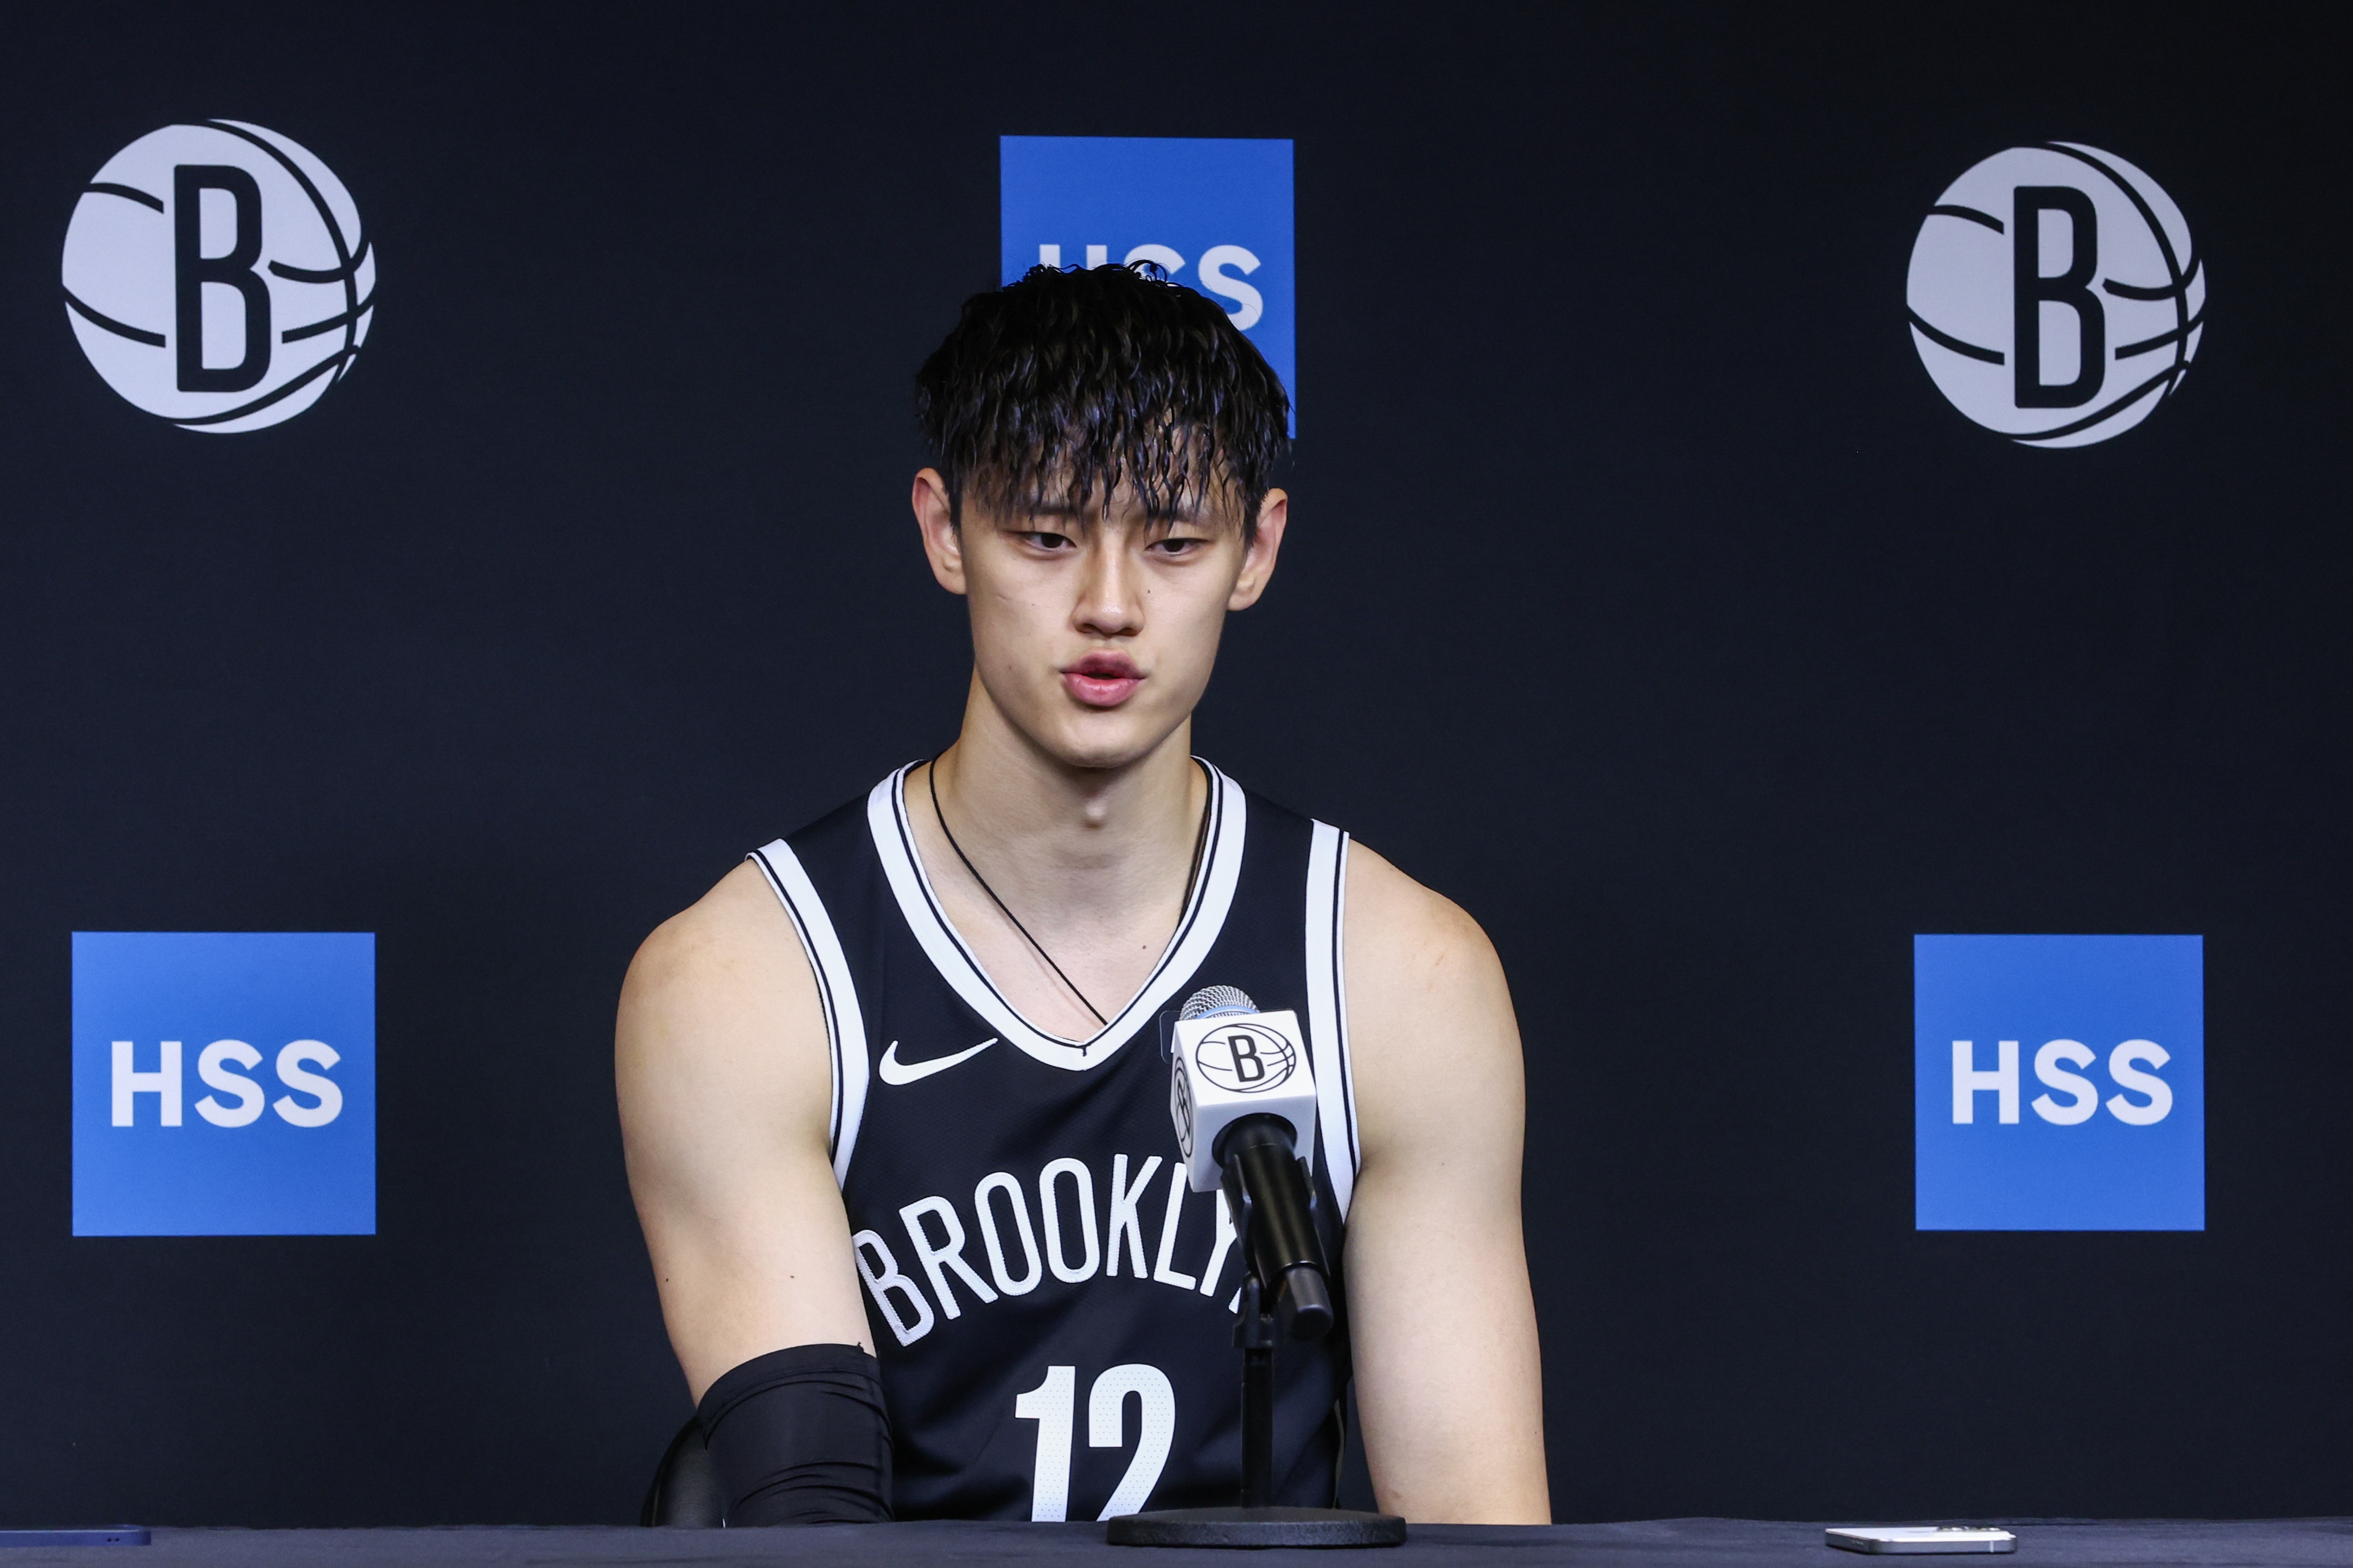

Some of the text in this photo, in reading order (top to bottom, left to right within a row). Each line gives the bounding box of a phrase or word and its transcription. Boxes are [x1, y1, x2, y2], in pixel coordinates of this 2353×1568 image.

[173, 164, 272, 393] B
[2013, 185, 2106, 409] B
[112, 1040, 342, 1128] HSS
[1228, 1035, 1265, 1083] B
[1952, 1039, 2173, 1125] HSS
[852, 1153, 1242, 1347] BROOKLY
[1015, 1364, 1176, 1523] 12
